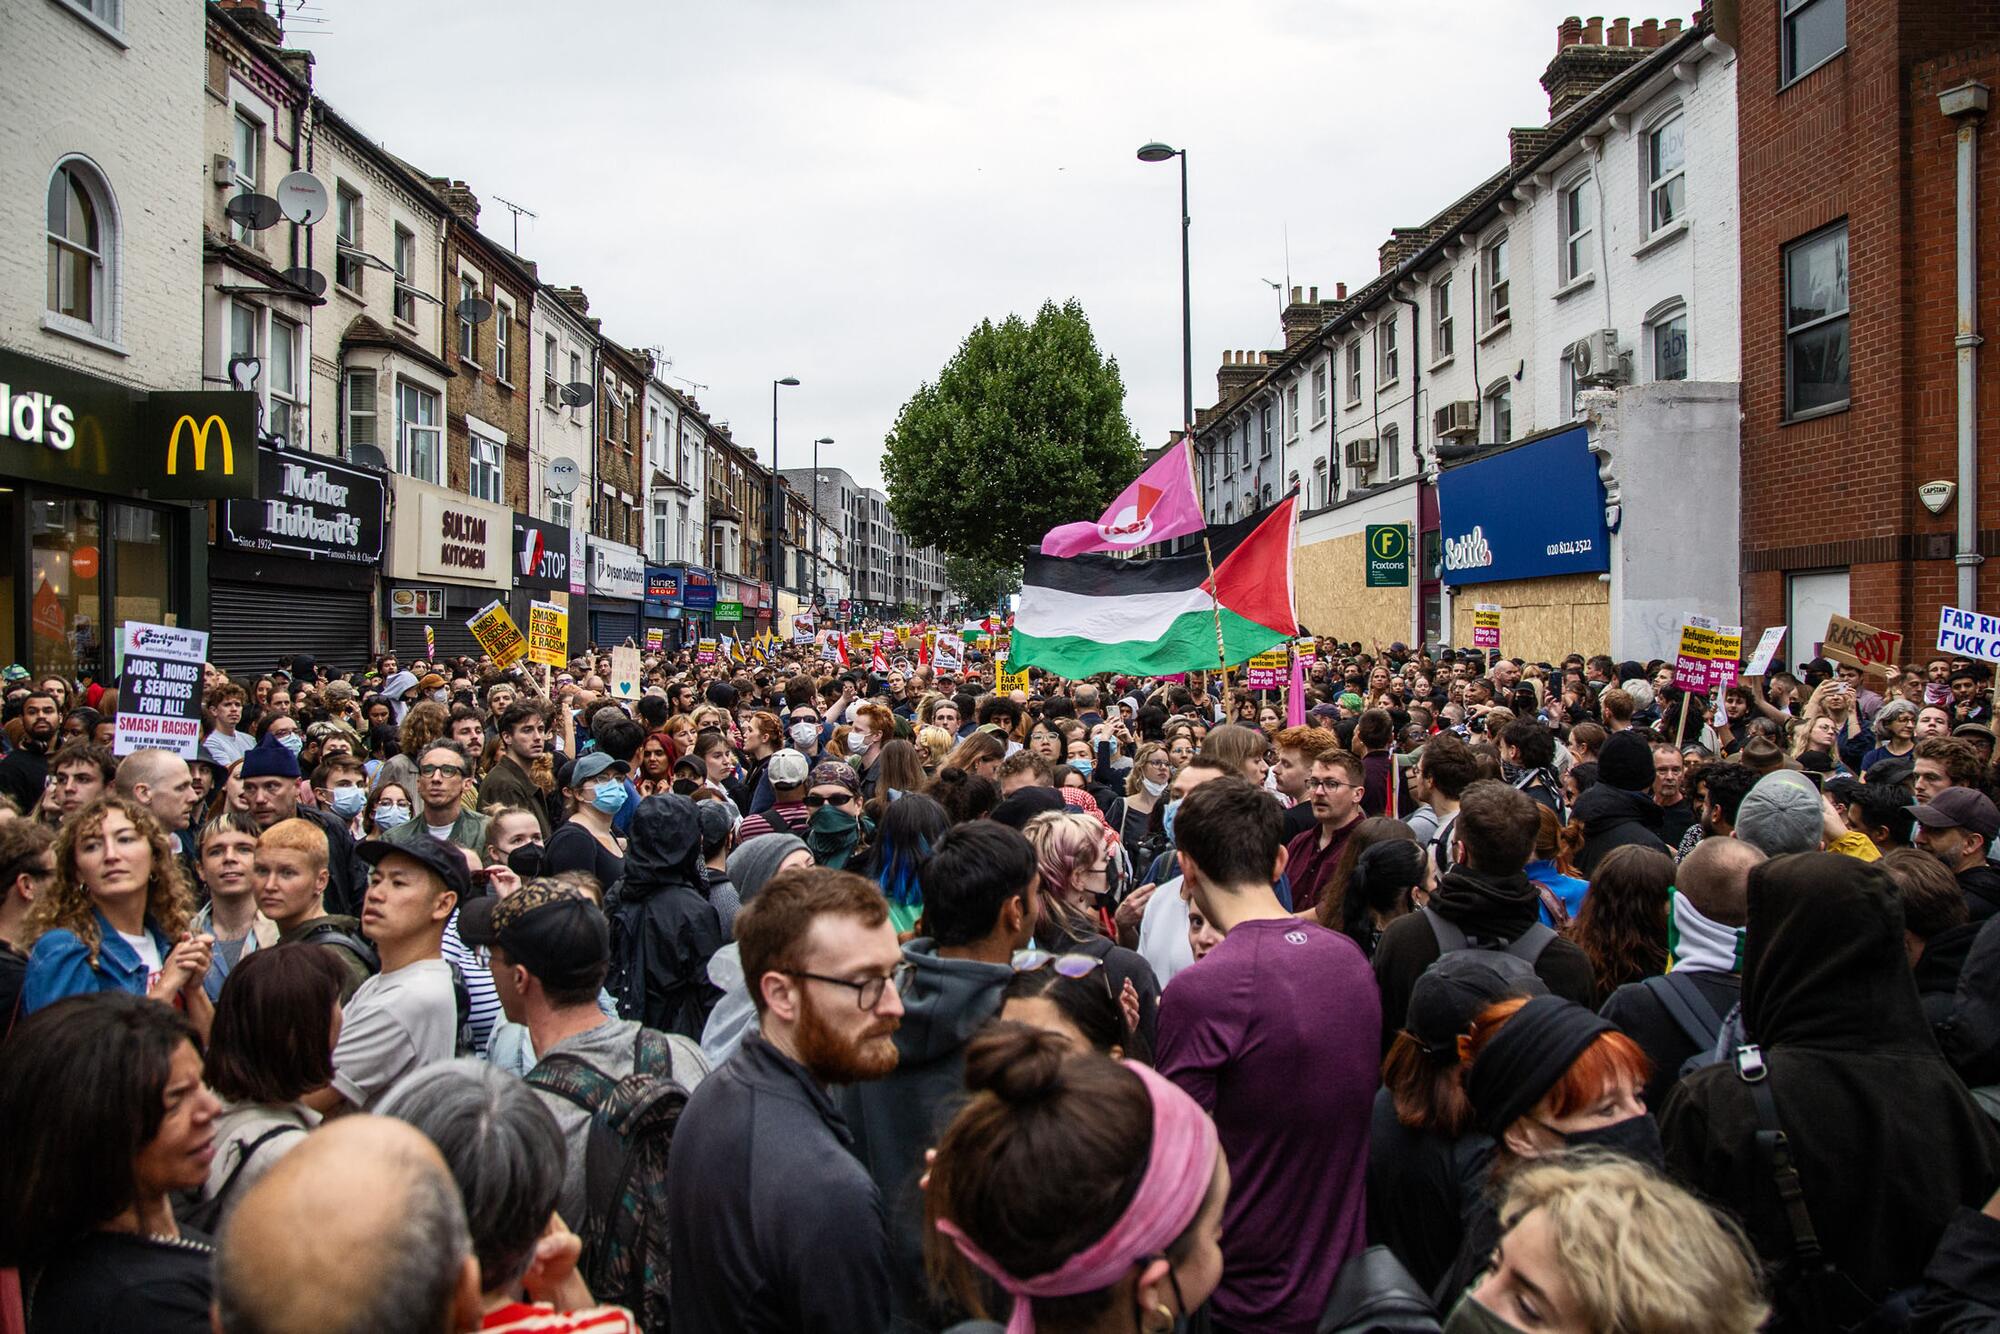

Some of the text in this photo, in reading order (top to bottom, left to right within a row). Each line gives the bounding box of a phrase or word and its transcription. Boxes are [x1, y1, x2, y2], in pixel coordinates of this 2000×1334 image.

[280, 464, 348, 508] Mother
[1923, 486, 1947, 494] CAPSTAN
[442, 510, 486, 546] SULTAN
[238, 536, 272, 550] Since 1972
[1546, 539, 1592, 556] 020 8124 2522
[327, 548, 375, 564] Famous Fish & Chips
[441, 543, 486, 570] KITCHEN
[540, 550, 566, 579] STOP
[1371, 560, 1405, 570] Foxtons
[606, 564, 622, 583] Dyson
[622, 566, 643, 584] Solicitors
[650, 577, 676, 588] kings
[473, 614, 497, 635] SMASH
[532, 609, 558, 624] SMASH
[1943, 608, 2000, 635] FAR RI
[145, 628, 188, 642] Socialist
[481, 621, 510, 646] FASCISM
[531, 622, 562, 638] FASCISM
[1475, 627, 1489, 636] Stop
[1683, 627, 1715, 644] Refugees
[489, 647, 496, 657] &
[495, 629, 521, 653] RACISM
[530, 635, 565, 652] & RACISM
[1681, 641, 1711, 655] welcome
[1714, 637, 1739, 647] efugees
[1855, 631, 1901, 666] OUT
[1940, 629, 1985, 656] FUCK
[127, 659, 198, 682] JOBS, HOMES
[1678, 657, 1707, 672] Stop the
[1724, 661, 1735, 670] the
[1001, 675, 1015, 683] FAR
[1250, 669, 1265, 678] Stop
[1265, 670, 1273, 678] the
[1261, 677, 1274, 685] right
[1676, 670, 1705, 686] far right
[1709, 670, 1718, 678] ar
[133, 679, 193, 699] & SERVICES
[1001, 683, 1025, 691] RIGHT
[139, 697, 185, 716] FOR ALL!
[119, 717, 197, 736] SMASH RACISM
